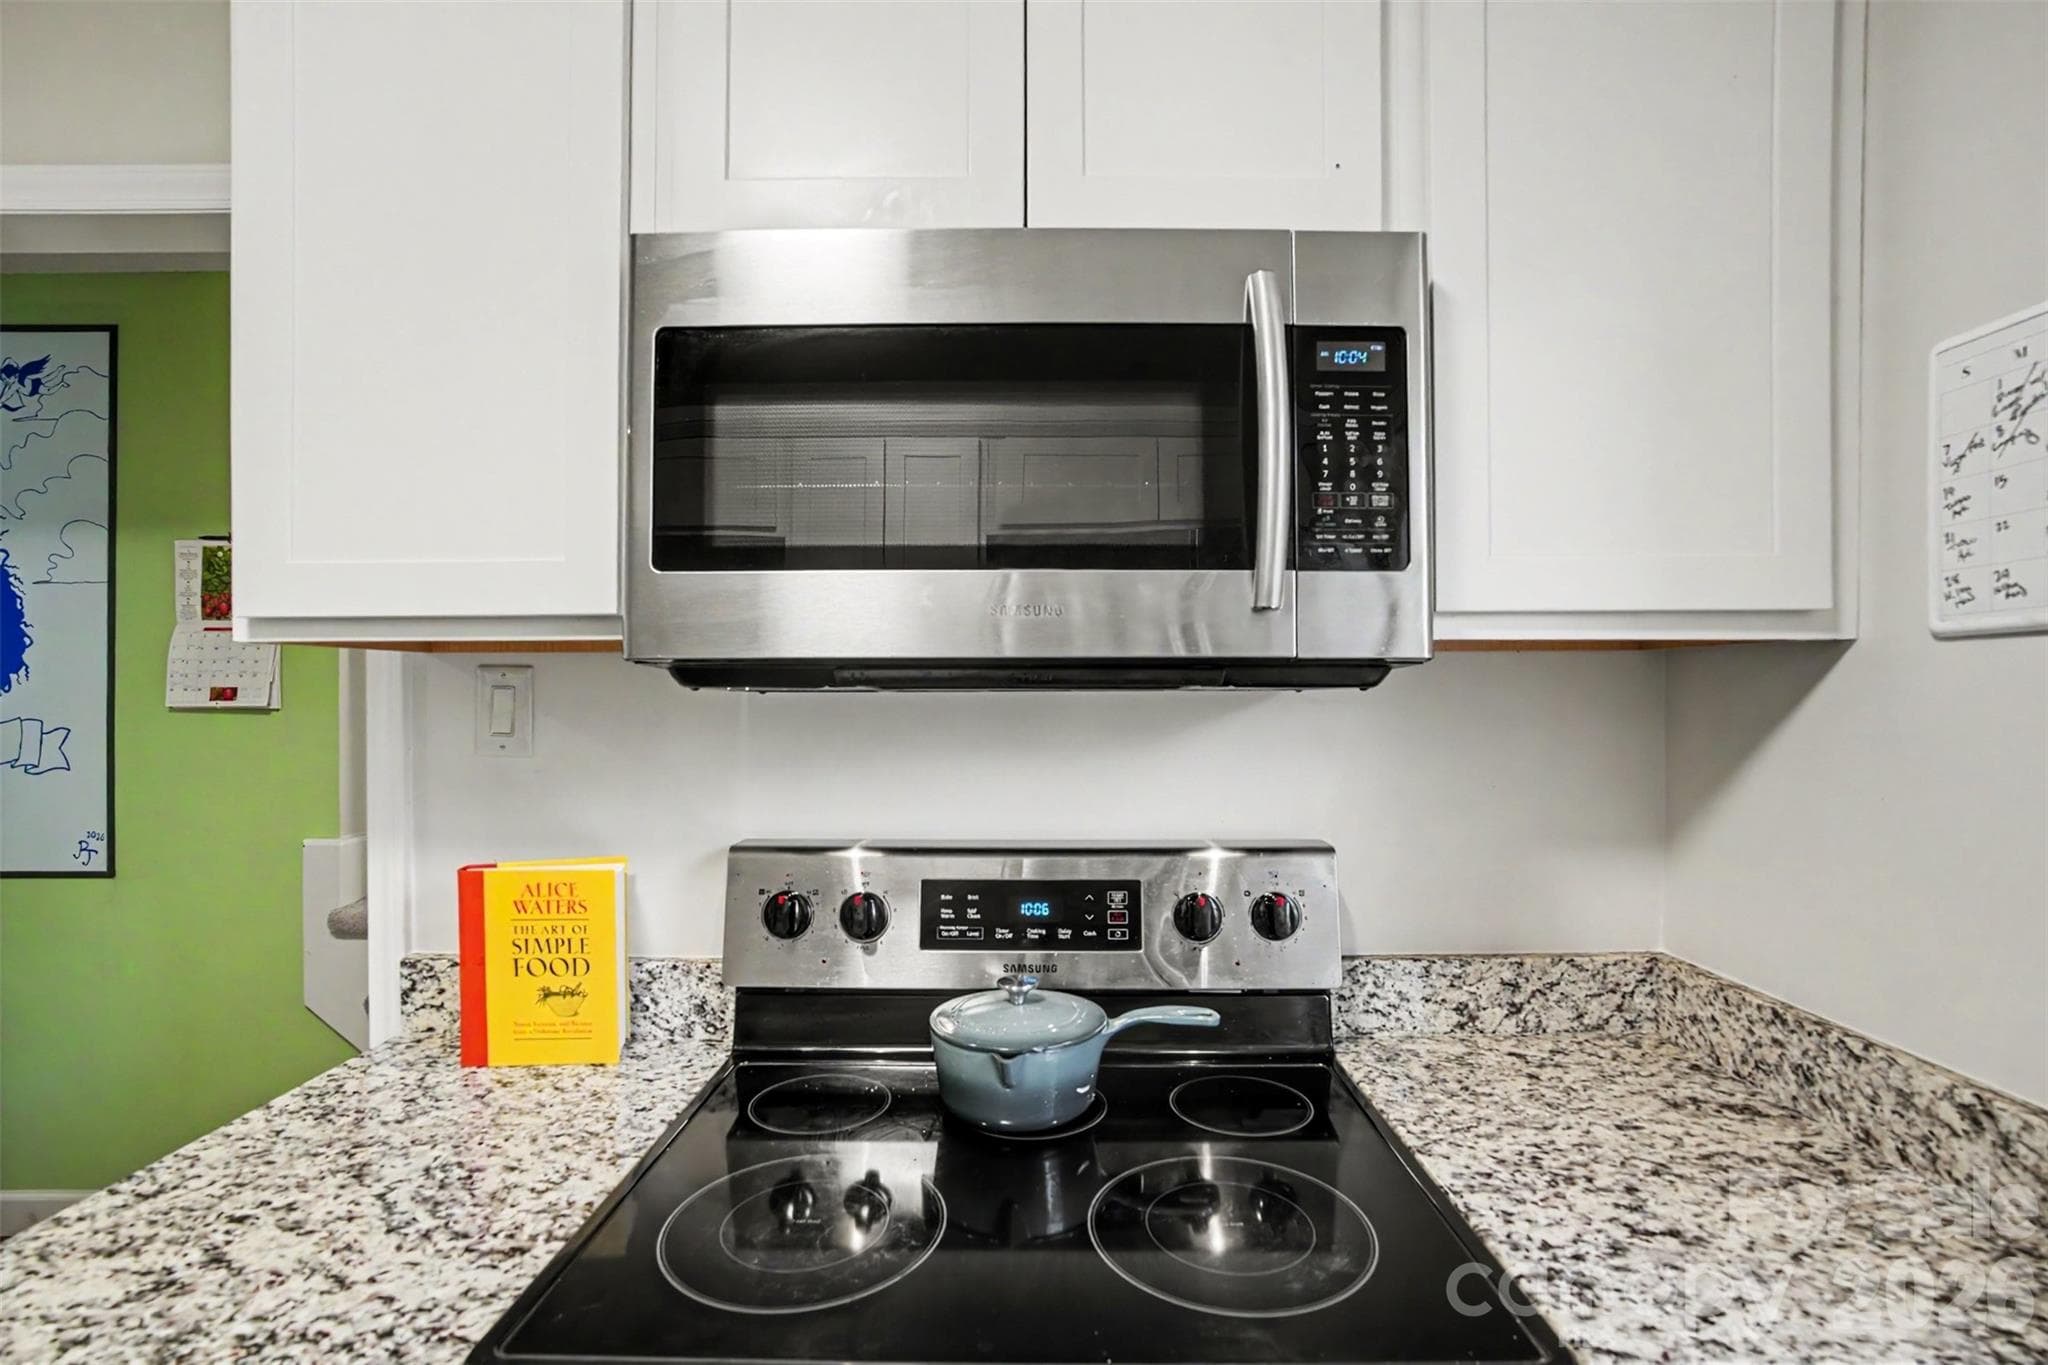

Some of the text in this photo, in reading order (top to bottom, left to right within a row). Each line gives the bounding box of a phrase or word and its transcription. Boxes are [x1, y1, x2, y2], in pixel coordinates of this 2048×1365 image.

[1321, 457, 1384, 466] 4 5 6
[1321, 469, 1329, 478] 7
[1376, 469, 1384, 478] 9
[1348, 482, 1357, 492] 0
[990, 603, 1064, 617] SAMSUNG
[521, 882, 580, 898] ALICE
[513, 899, 589, 914] WATERS
[513, 924, 588, 936] THE ART OF
[511, 938, 591, 955] SIMPLE
[513, 957, 591, 978] FOOD
[1003, 963, 1058, 974] SAMSUNG
